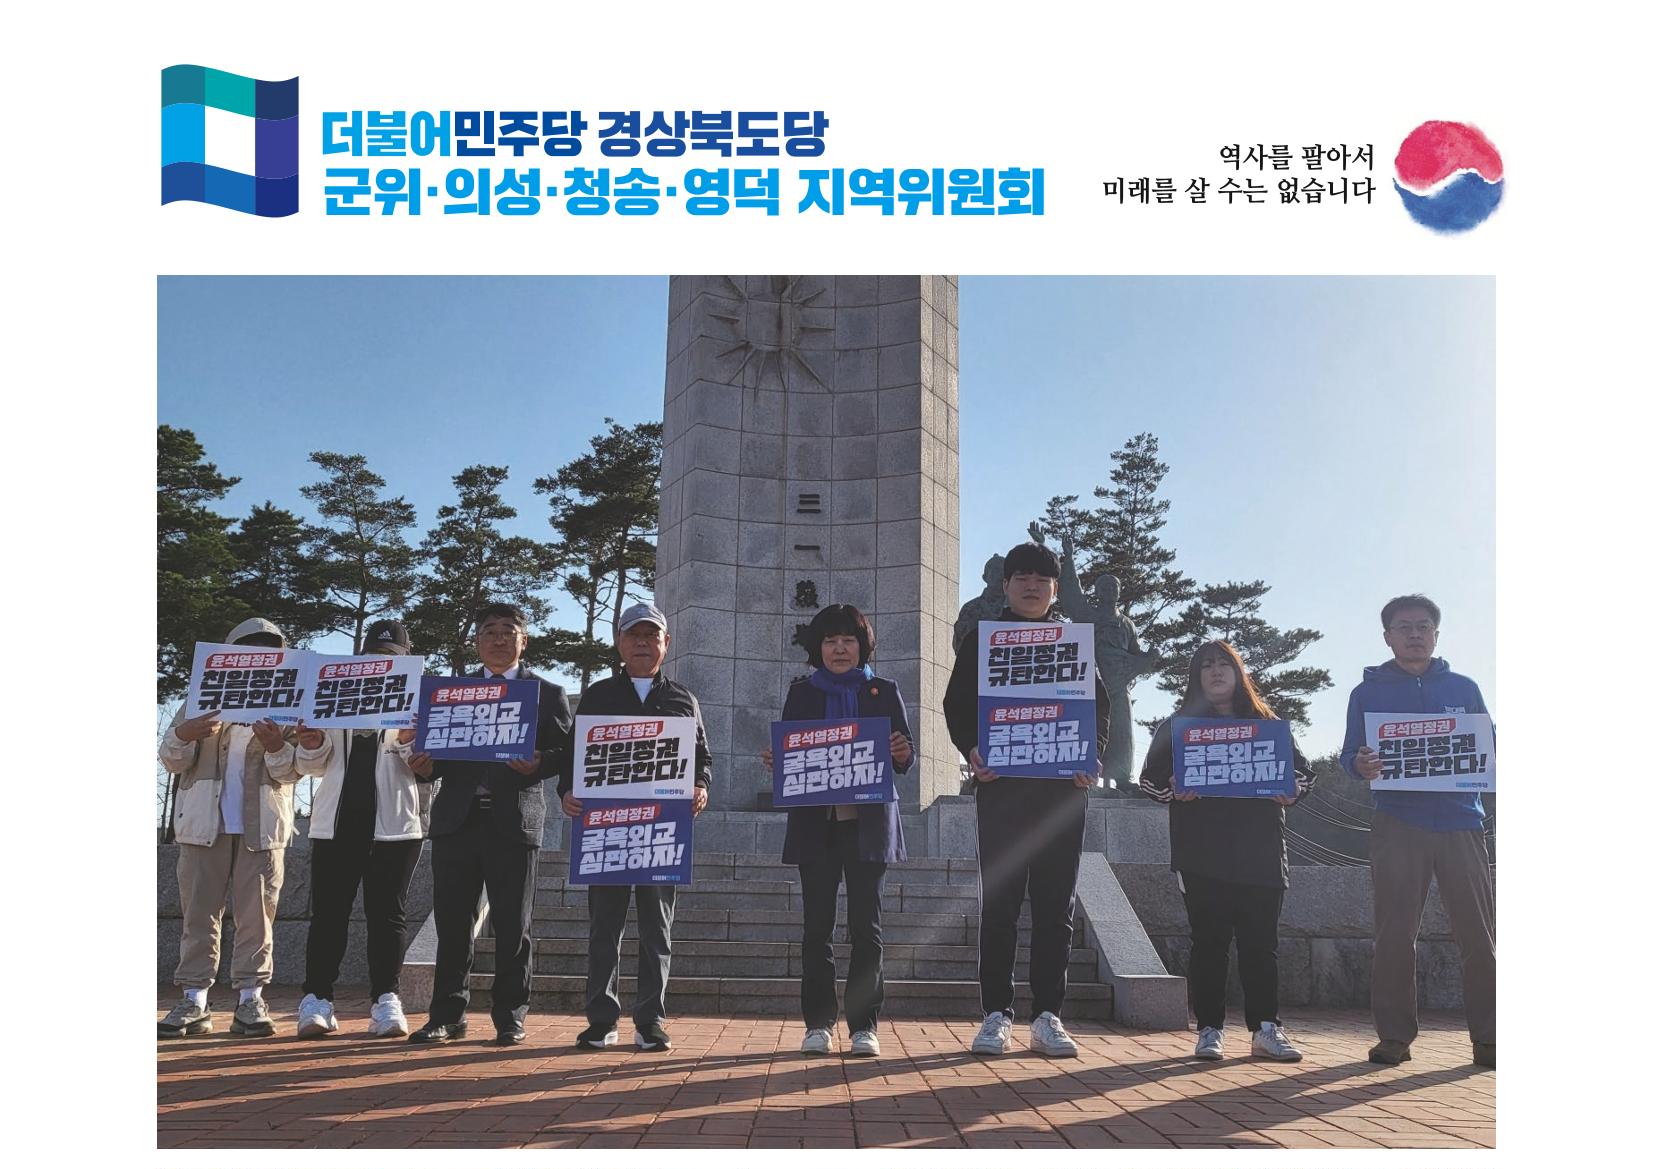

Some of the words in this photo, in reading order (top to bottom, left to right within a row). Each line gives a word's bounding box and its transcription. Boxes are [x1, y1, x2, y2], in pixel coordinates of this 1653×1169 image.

[994, 629, 1057, 644] 윤석열정권
[210, 652, 279, 669] 윤석열정권
[988, 642, 1078, 667] 친일정권
[200, 668, 298, 689] 친일정권
[323, 660, 388, 678] 윤석열정권
[988, 662, 1088, 687] 규탄한다!
[314, 673, 407, 699] 친일정권
[435, 685, 502, 702] 윤석열정권
[198, 688, 305, 711] 규탄한다!
[312, 692, 414, 719] 규탄한다!
[427, 702, 523, 728] 굴욕외교
[994, 706, 1057, 722] 윤석열정권
[424, 723, 527, 749] 심판하자!
[592, 721, 659, 741] 윤석열정권
[788, 725, 853, 748] 윤석열정권
[988, 720, 1080, 746] 굴욕외교
[1188, 727, 1253, 742] 윤석열정권
[1383, 719, 1451, 736] 윤석열정권
[584, 737, 680, 766] 친일정권
[783, 740, 875, 775] 굴욕외교
[987, 741, 1090, 767] 심판하자!
[1184, 740, 1276, 766] 굴욕외교
[1378, 733, 1477, 760] 친일정권
[584, 759, 688, 788] 규탄한다!
[1184, 761, 1286, 787] 심판하자!
[1379, 753, 1487, 780] 규탄한다!
[782, 762, 885, 798] 심판하자!
[589, 806, 655, 825] 윤석열정권
[581, 821, 677, 852] 굴욕외교
[579, 843, 685, 875] 심판하자!
